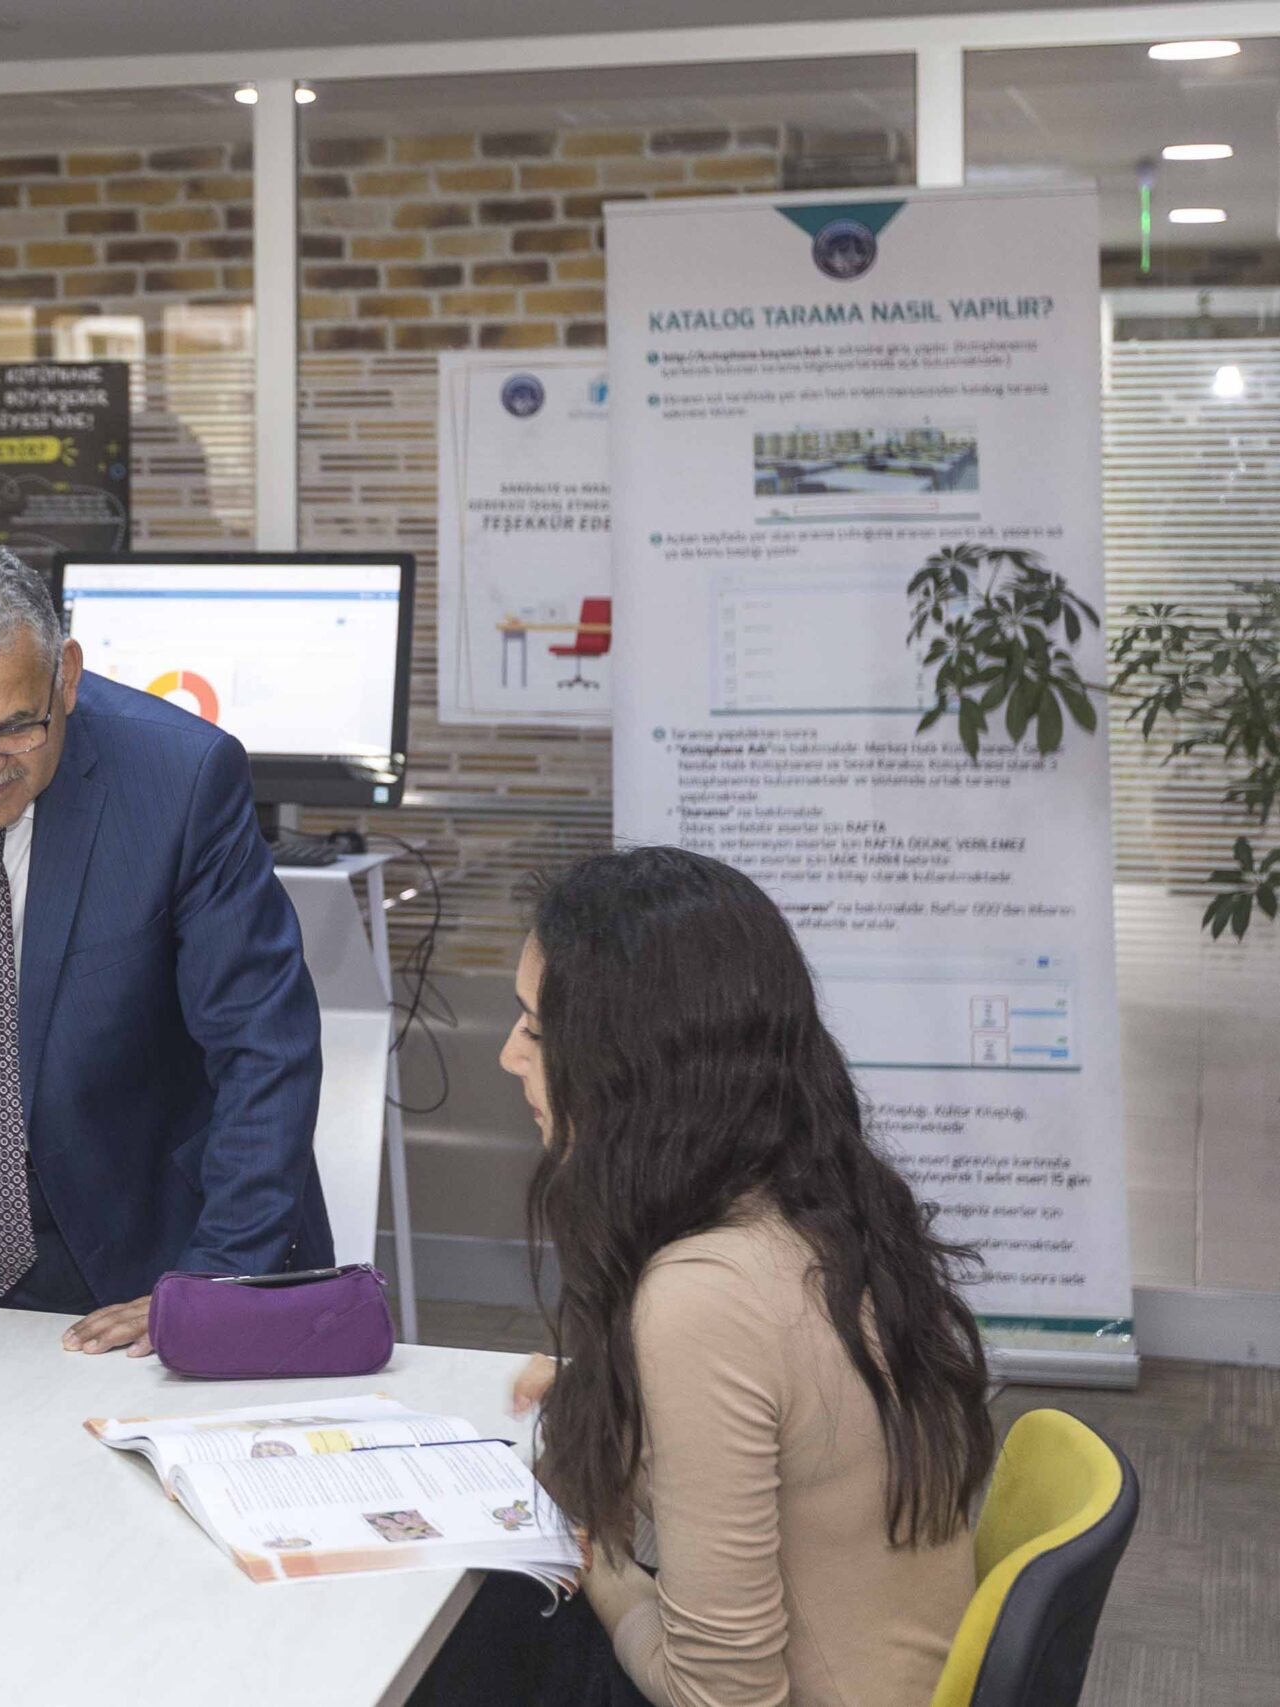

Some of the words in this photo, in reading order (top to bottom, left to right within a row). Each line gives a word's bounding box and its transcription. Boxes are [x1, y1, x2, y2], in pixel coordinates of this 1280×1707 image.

[648, 307, 756, 334] KATALOG
[761, 303, 865, 328] TARAMA
[871, 299, 942, 325] NASIL
[948, 294, 1055, 320] YAPILIR?
